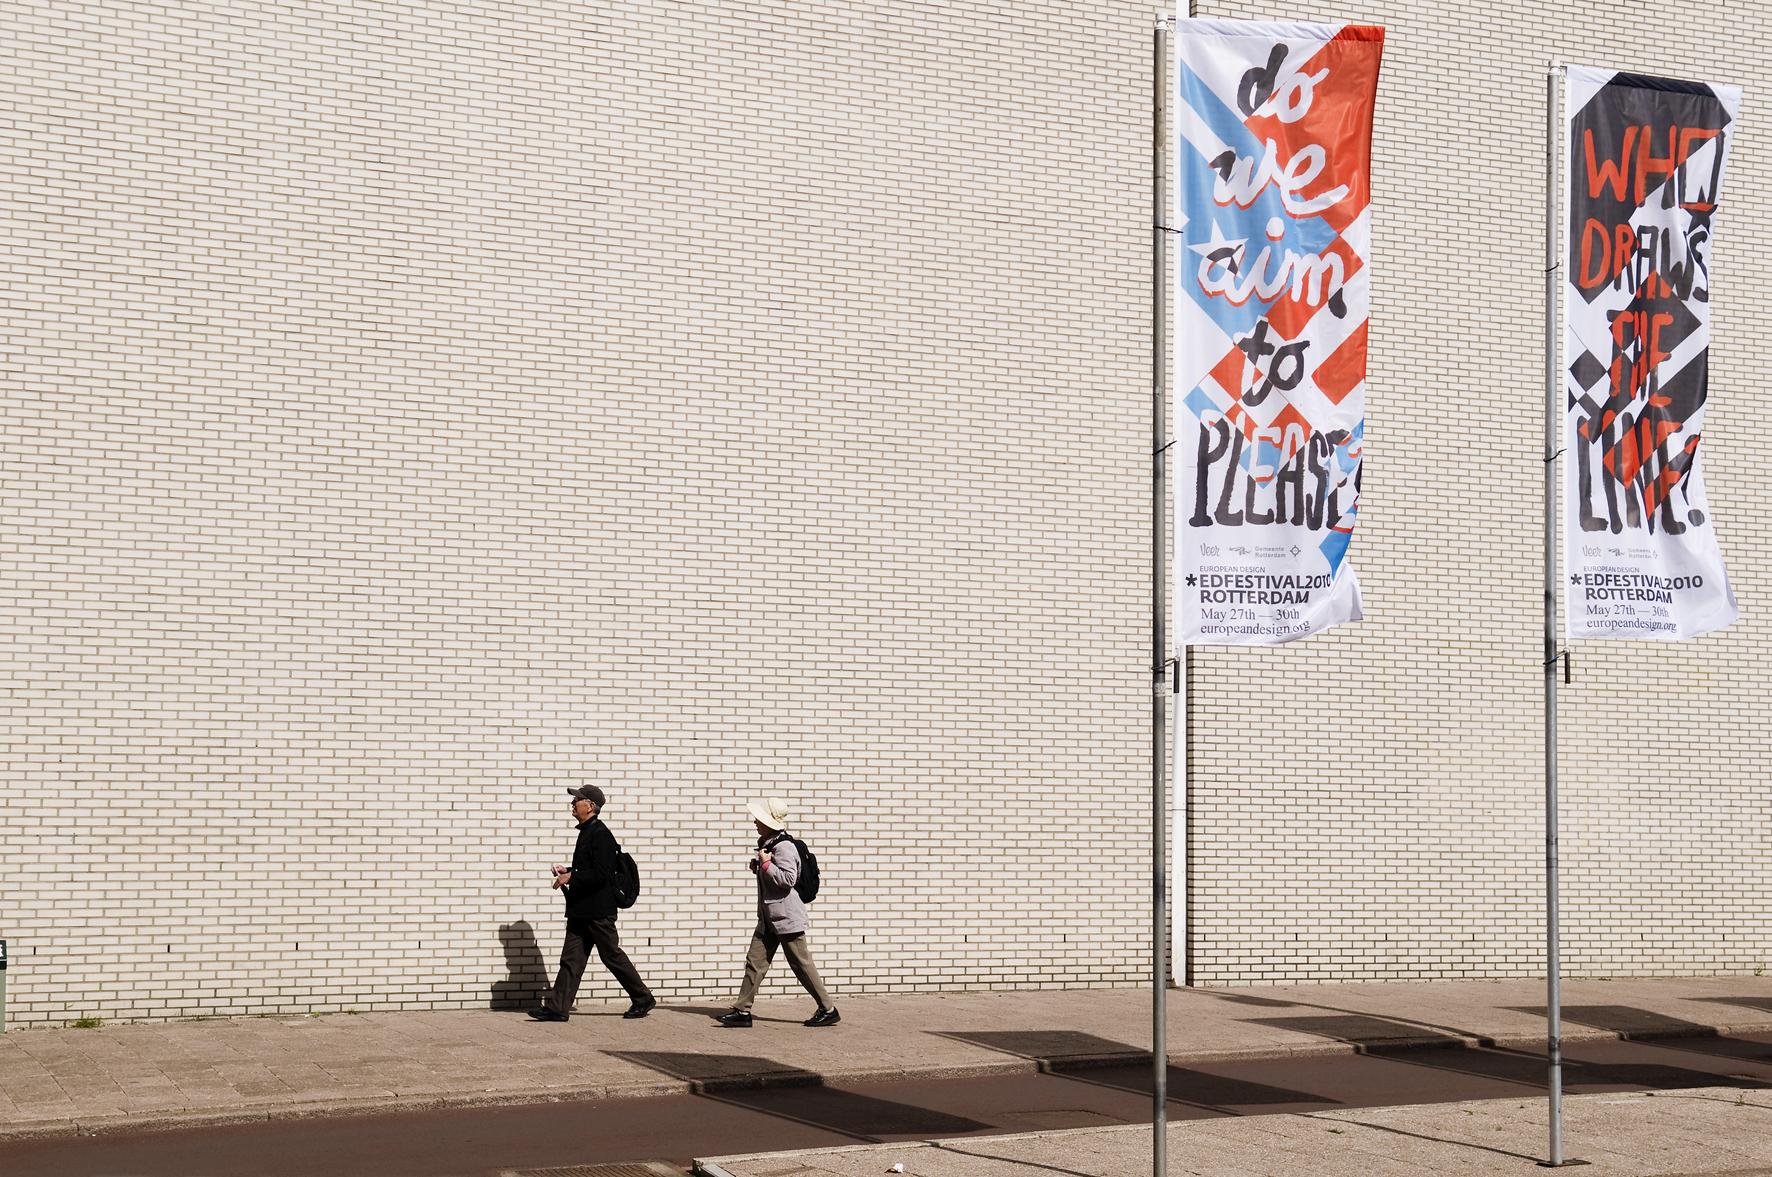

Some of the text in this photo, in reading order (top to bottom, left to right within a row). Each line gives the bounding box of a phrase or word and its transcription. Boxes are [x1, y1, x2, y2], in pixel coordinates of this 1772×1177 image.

[1237, 43, 1330, 123] do
[1209, 137, 1349, 219] we
[1584, 125, 1727, 212] WHO
[1197, 217, 1348, 319] aim
[1579, 218, 1710, 303] DRAWS
[1233, 315, 1310, 407] to
[1606, 309, 1674, 408] THE
[1583, 565, 1616, 573] EUROPEAN
[1200, 589, 1310, 605] ROTTERDAM
[1201, 608, 1227, 622] May
[1230, 608, 1256, 620] 27th
[1275, 608, 1300, 620] 30th
[1585, 587, 1673, 604] ROTTERDAM
[1586, 604, 1611, 617] May
[1613, 605, 1635, 616] 27th
[1652, 606, 1669, 618] 30th
[1200, 620, 1310, 636] europeandesign.org
[1586, 618, 1677, 633] europeandesign.org
